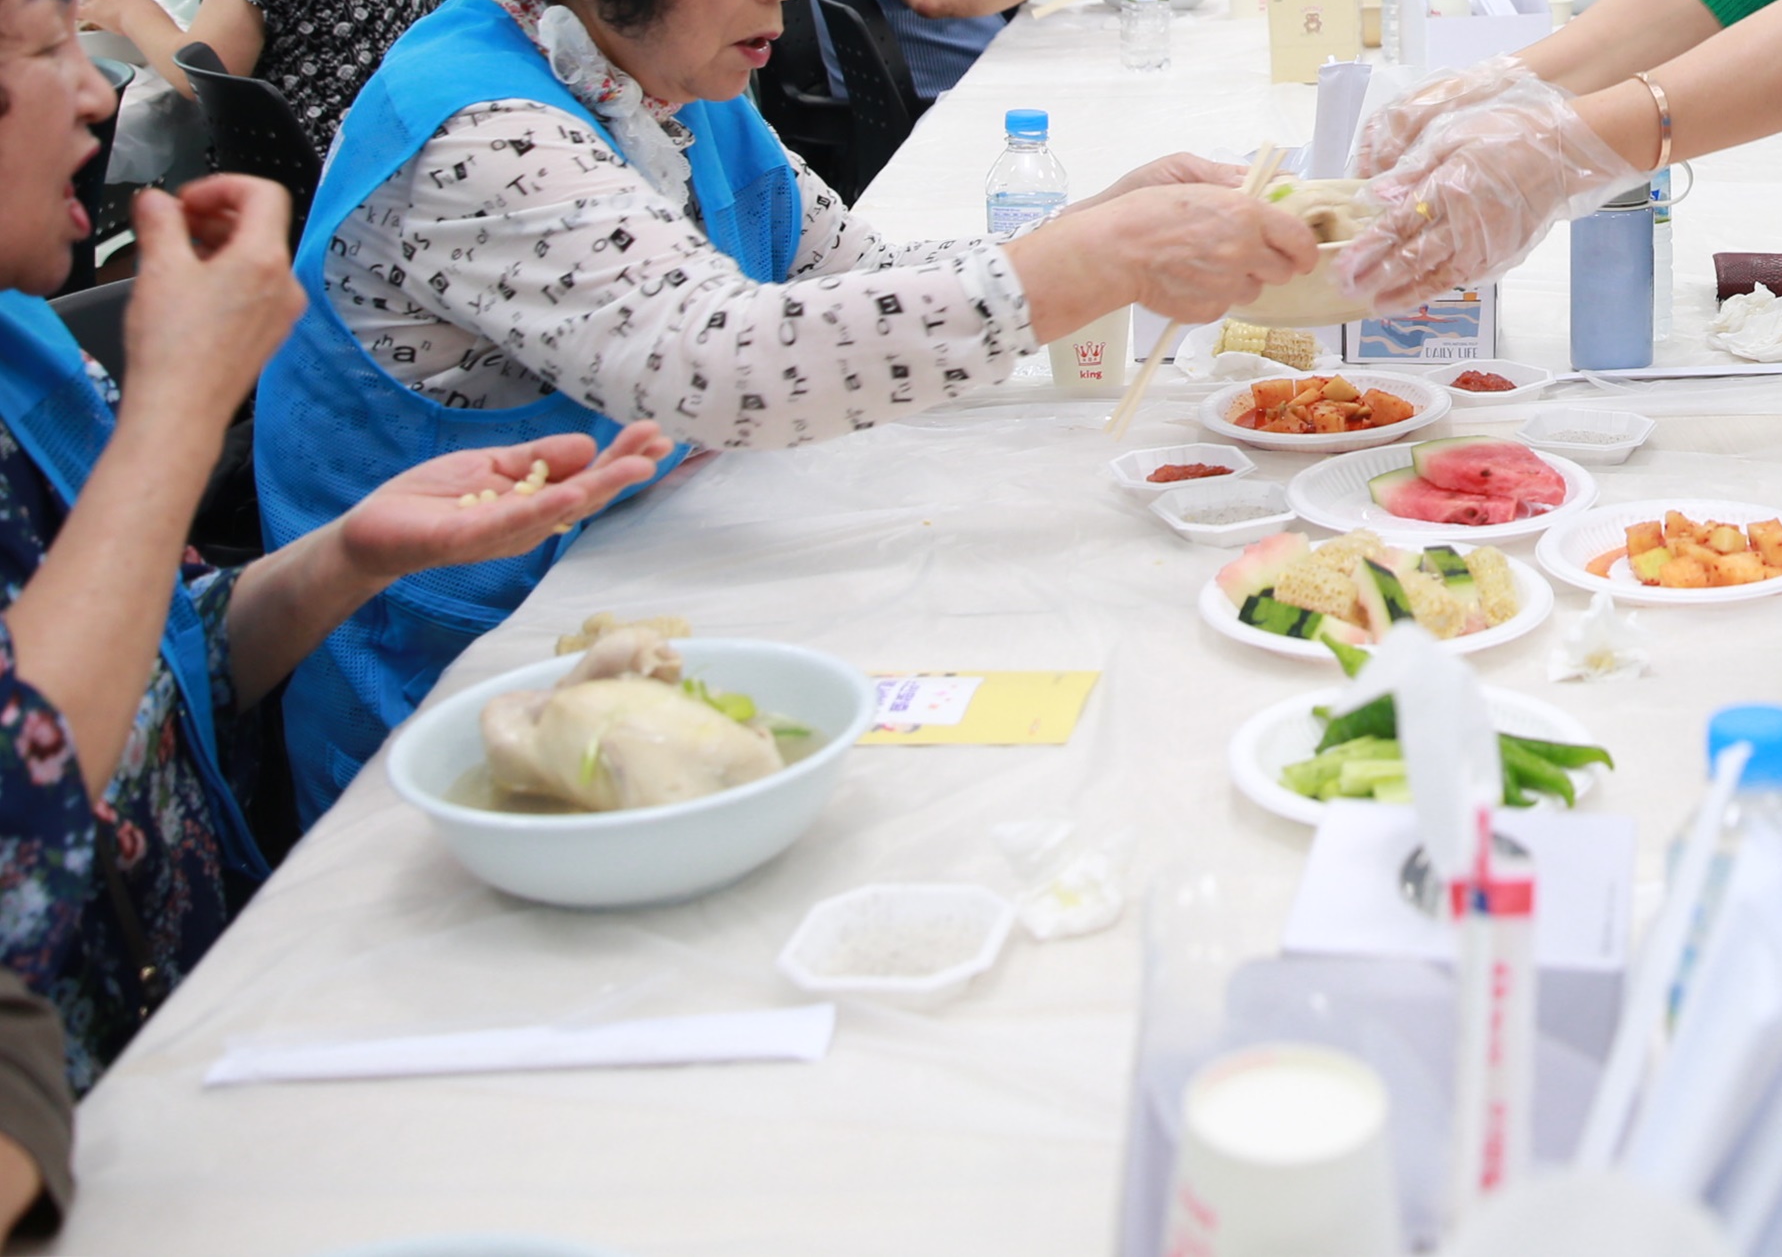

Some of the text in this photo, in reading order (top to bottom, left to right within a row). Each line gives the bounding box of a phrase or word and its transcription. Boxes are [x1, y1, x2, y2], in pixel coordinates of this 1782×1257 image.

[371, 333, 433, 365] than
[1425, 347, 1478, 358] DAILY LIFE
[1079, 370, 1103, 380] king
